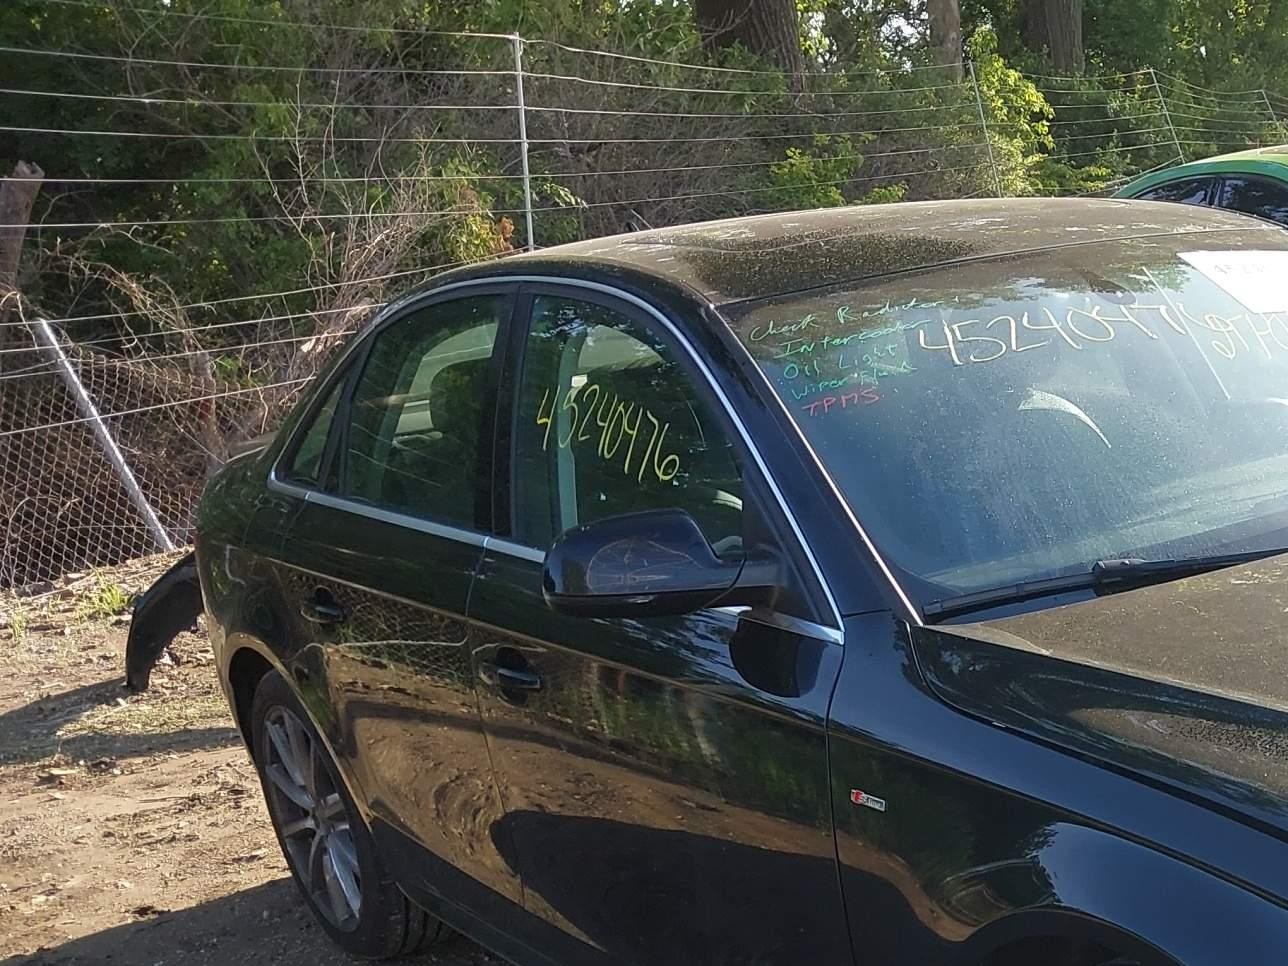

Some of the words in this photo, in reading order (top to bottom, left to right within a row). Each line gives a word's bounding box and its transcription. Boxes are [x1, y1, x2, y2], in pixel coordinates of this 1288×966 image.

[751, 313, 820, 341] Check
[784, 360, 821, 379] Oil
[802, 387, 879, 416] TPMS
[537, 384, 680, 483] 45240476
